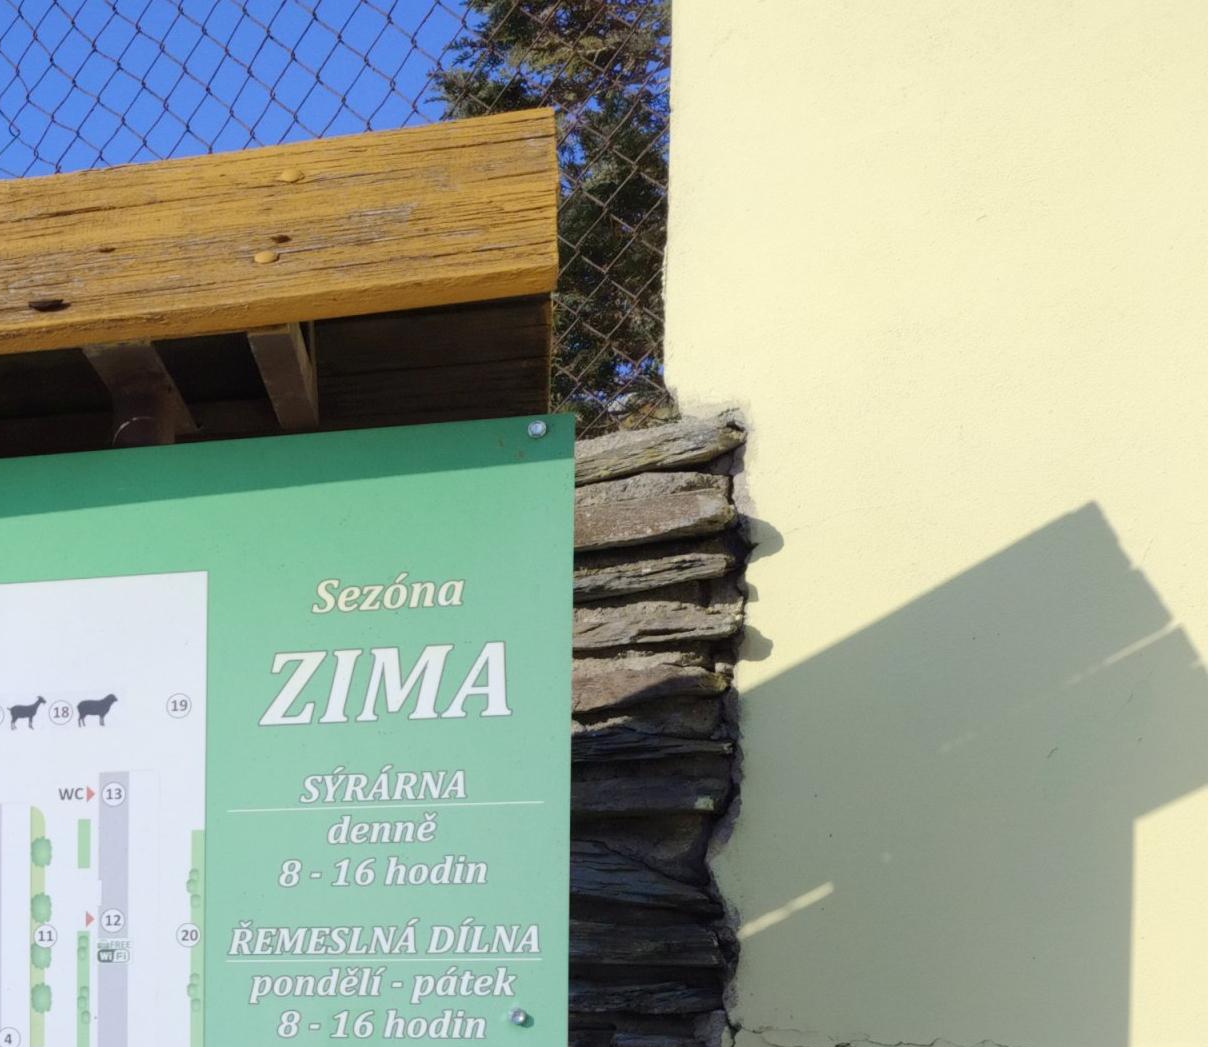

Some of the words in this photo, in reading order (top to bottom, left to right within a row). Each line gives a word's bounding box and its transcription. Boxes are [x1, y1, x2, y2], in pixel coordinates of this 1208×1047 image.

[311, 572, 465, 614] Sezóna
[258, 640, 513, 727] ZIMA
[53, 706, 69, 719] 18
[171, 699, 188, 712] 19
[58, 788, 84, 800] WC
[106, 788, 122, 801] 13
[299, 764, 468, 803] SÝRÁRNA
[327, 811, 438, 845] denně
[279, 859, 302, 887] 8
[330, 857, 376, 887] 16
[385, 855, 489, 887] hodin
[38, 930, 53, 942] 11
[105, 915, 121, 927] 12
[182, 929, 198, 941] 20
[228, 918, 418, 956] ŘEMESLNÁ
[428, 917, 542, 954] DÍLNA
[249, 965, 385, 1004] pondělí
[411, 966, 518, 1004] pátek
[277, 1010, 301, 1039] 8
[329, 1010, 374, 1039] 16
[383, 1007, 487, 1040] hodin
